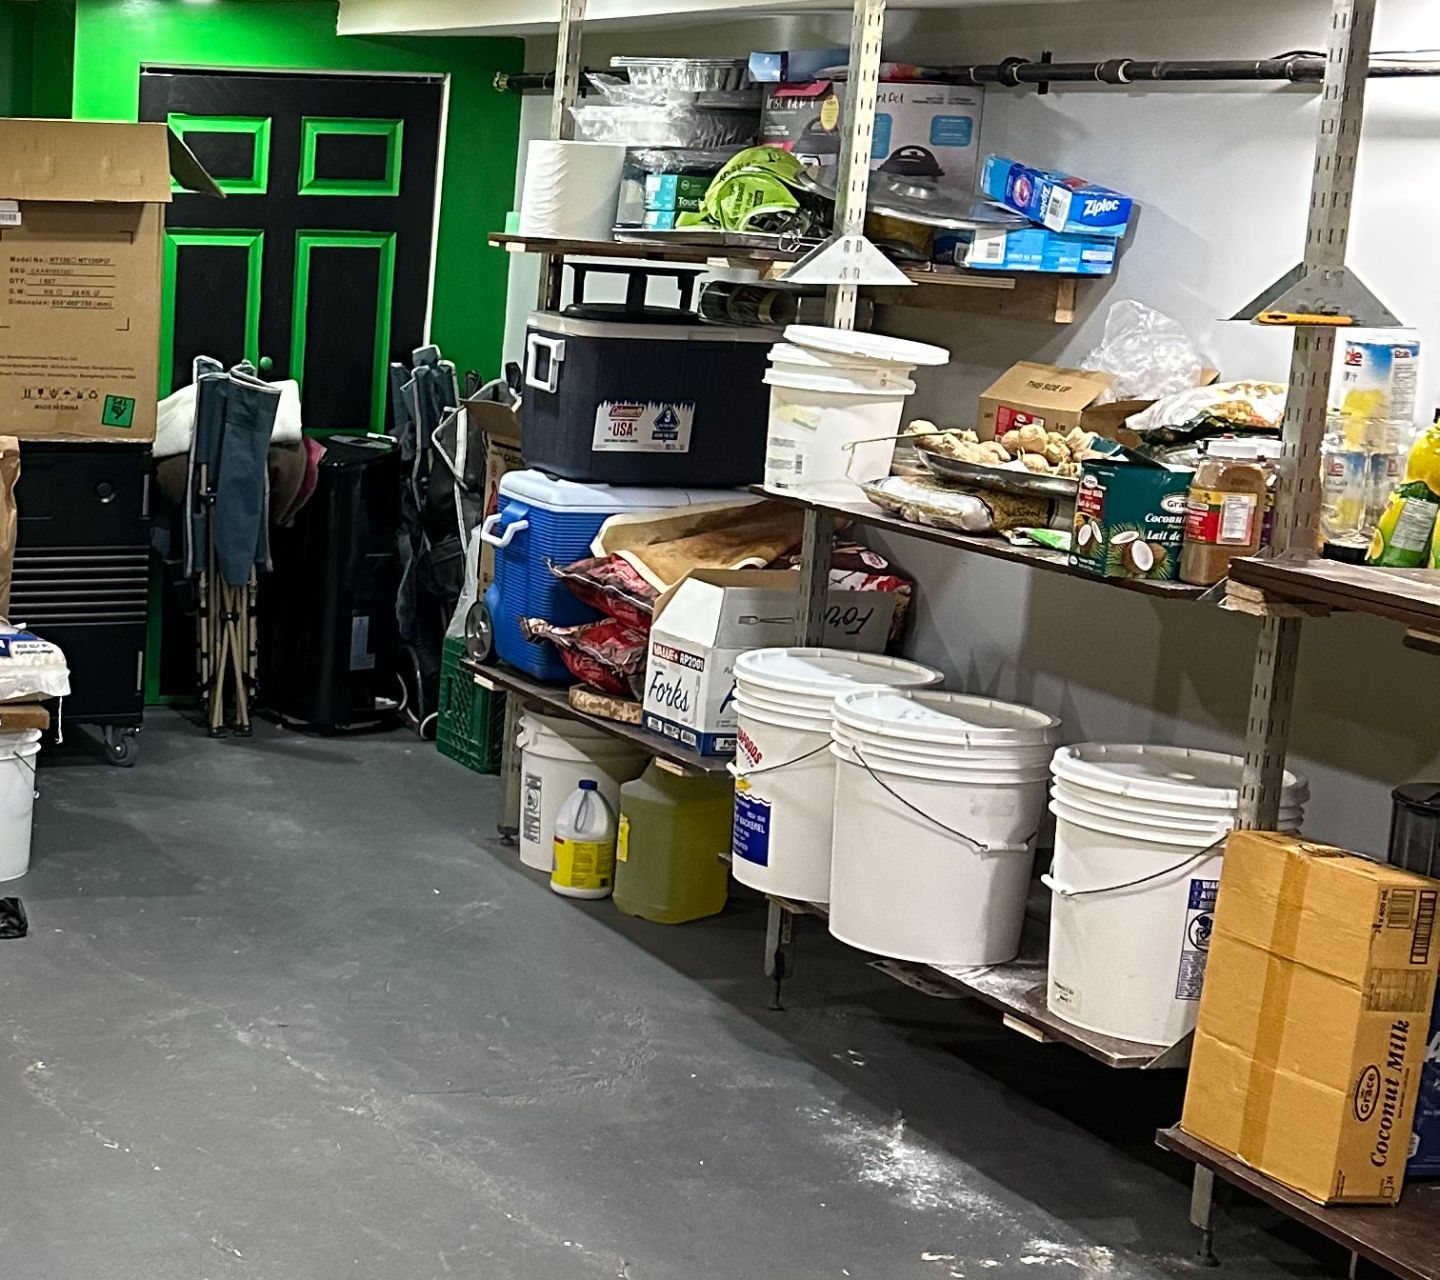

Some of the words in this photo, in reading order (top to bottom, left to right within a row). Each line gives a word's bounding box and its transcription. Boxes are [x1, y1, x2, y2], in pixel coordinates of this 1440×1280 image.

[677, 196, 700, 208] Touc
[1039, 184, 1051, 220] Ziploc
[1083, 197, 1121, 218] Ziploc
[664, 409, 672, 423] 3
[612, 422, 633, 437] USA
[1146, 530, 1167, 541] Lait
[653, 644, 679, 662] VALUE+
[679, 653, 704, 672] RP2001
[648, 670, 690, 713] Forks
[1360, 1073, 1376, 1114] Grace
[1370, 1076, 1400, 1168] Coconut
[1386, 1020, 1410, 1073] Milk
